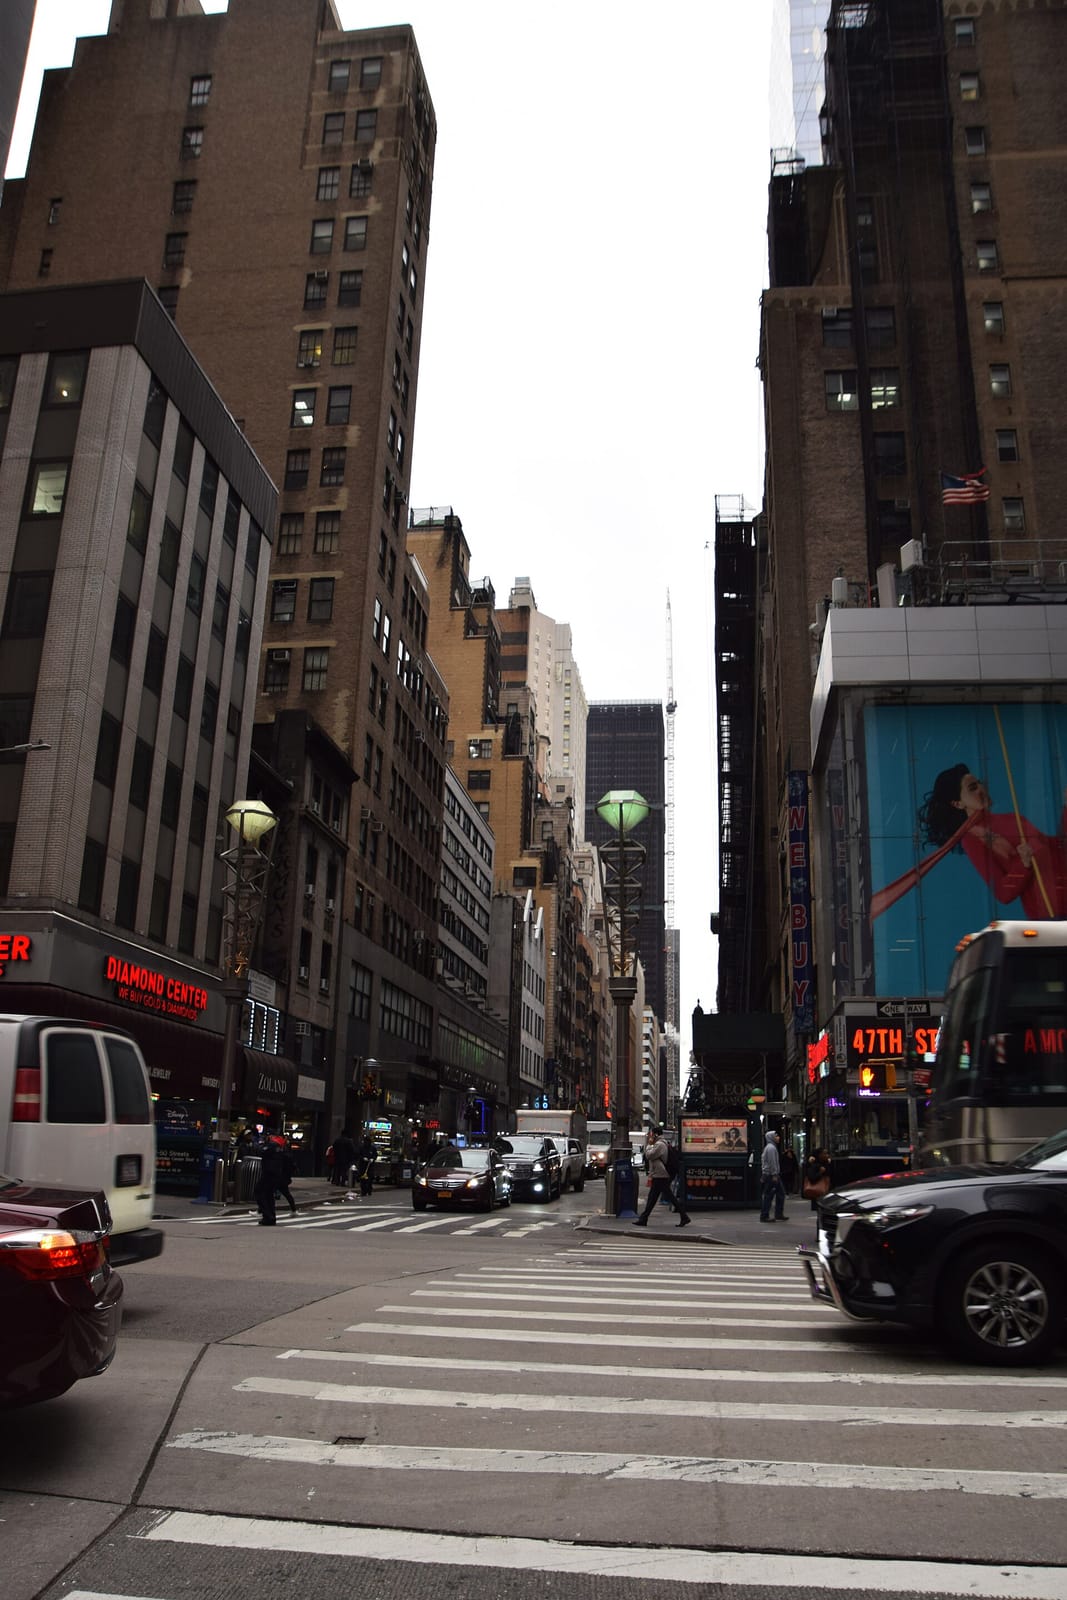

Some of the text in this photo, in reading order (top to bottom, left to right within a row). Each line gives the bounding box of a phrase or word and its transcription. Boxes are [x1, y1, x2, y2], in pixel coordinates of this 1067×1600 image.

[789, 805, 810, 1007] WE BUY
[107, 955, 165, 996] DIAMOND
[167, 978, 208, 1010] CENTER
[119, 987, 129, 1000] WE
[130, 990, 143, 1004] BUY
[143, 994, 160, 1009] GOLD
[168, 1002, 198, 1021] DIAMONDS
[884, 1004, 924, 1013] ONE WAY
[853, 1029, 903, 1054] 47TH
[915, 1028, 939, 1055] ST
[258, 1072, 288, 1095] ZOLAND
[686, 1168, 707, 1176] 47-50
